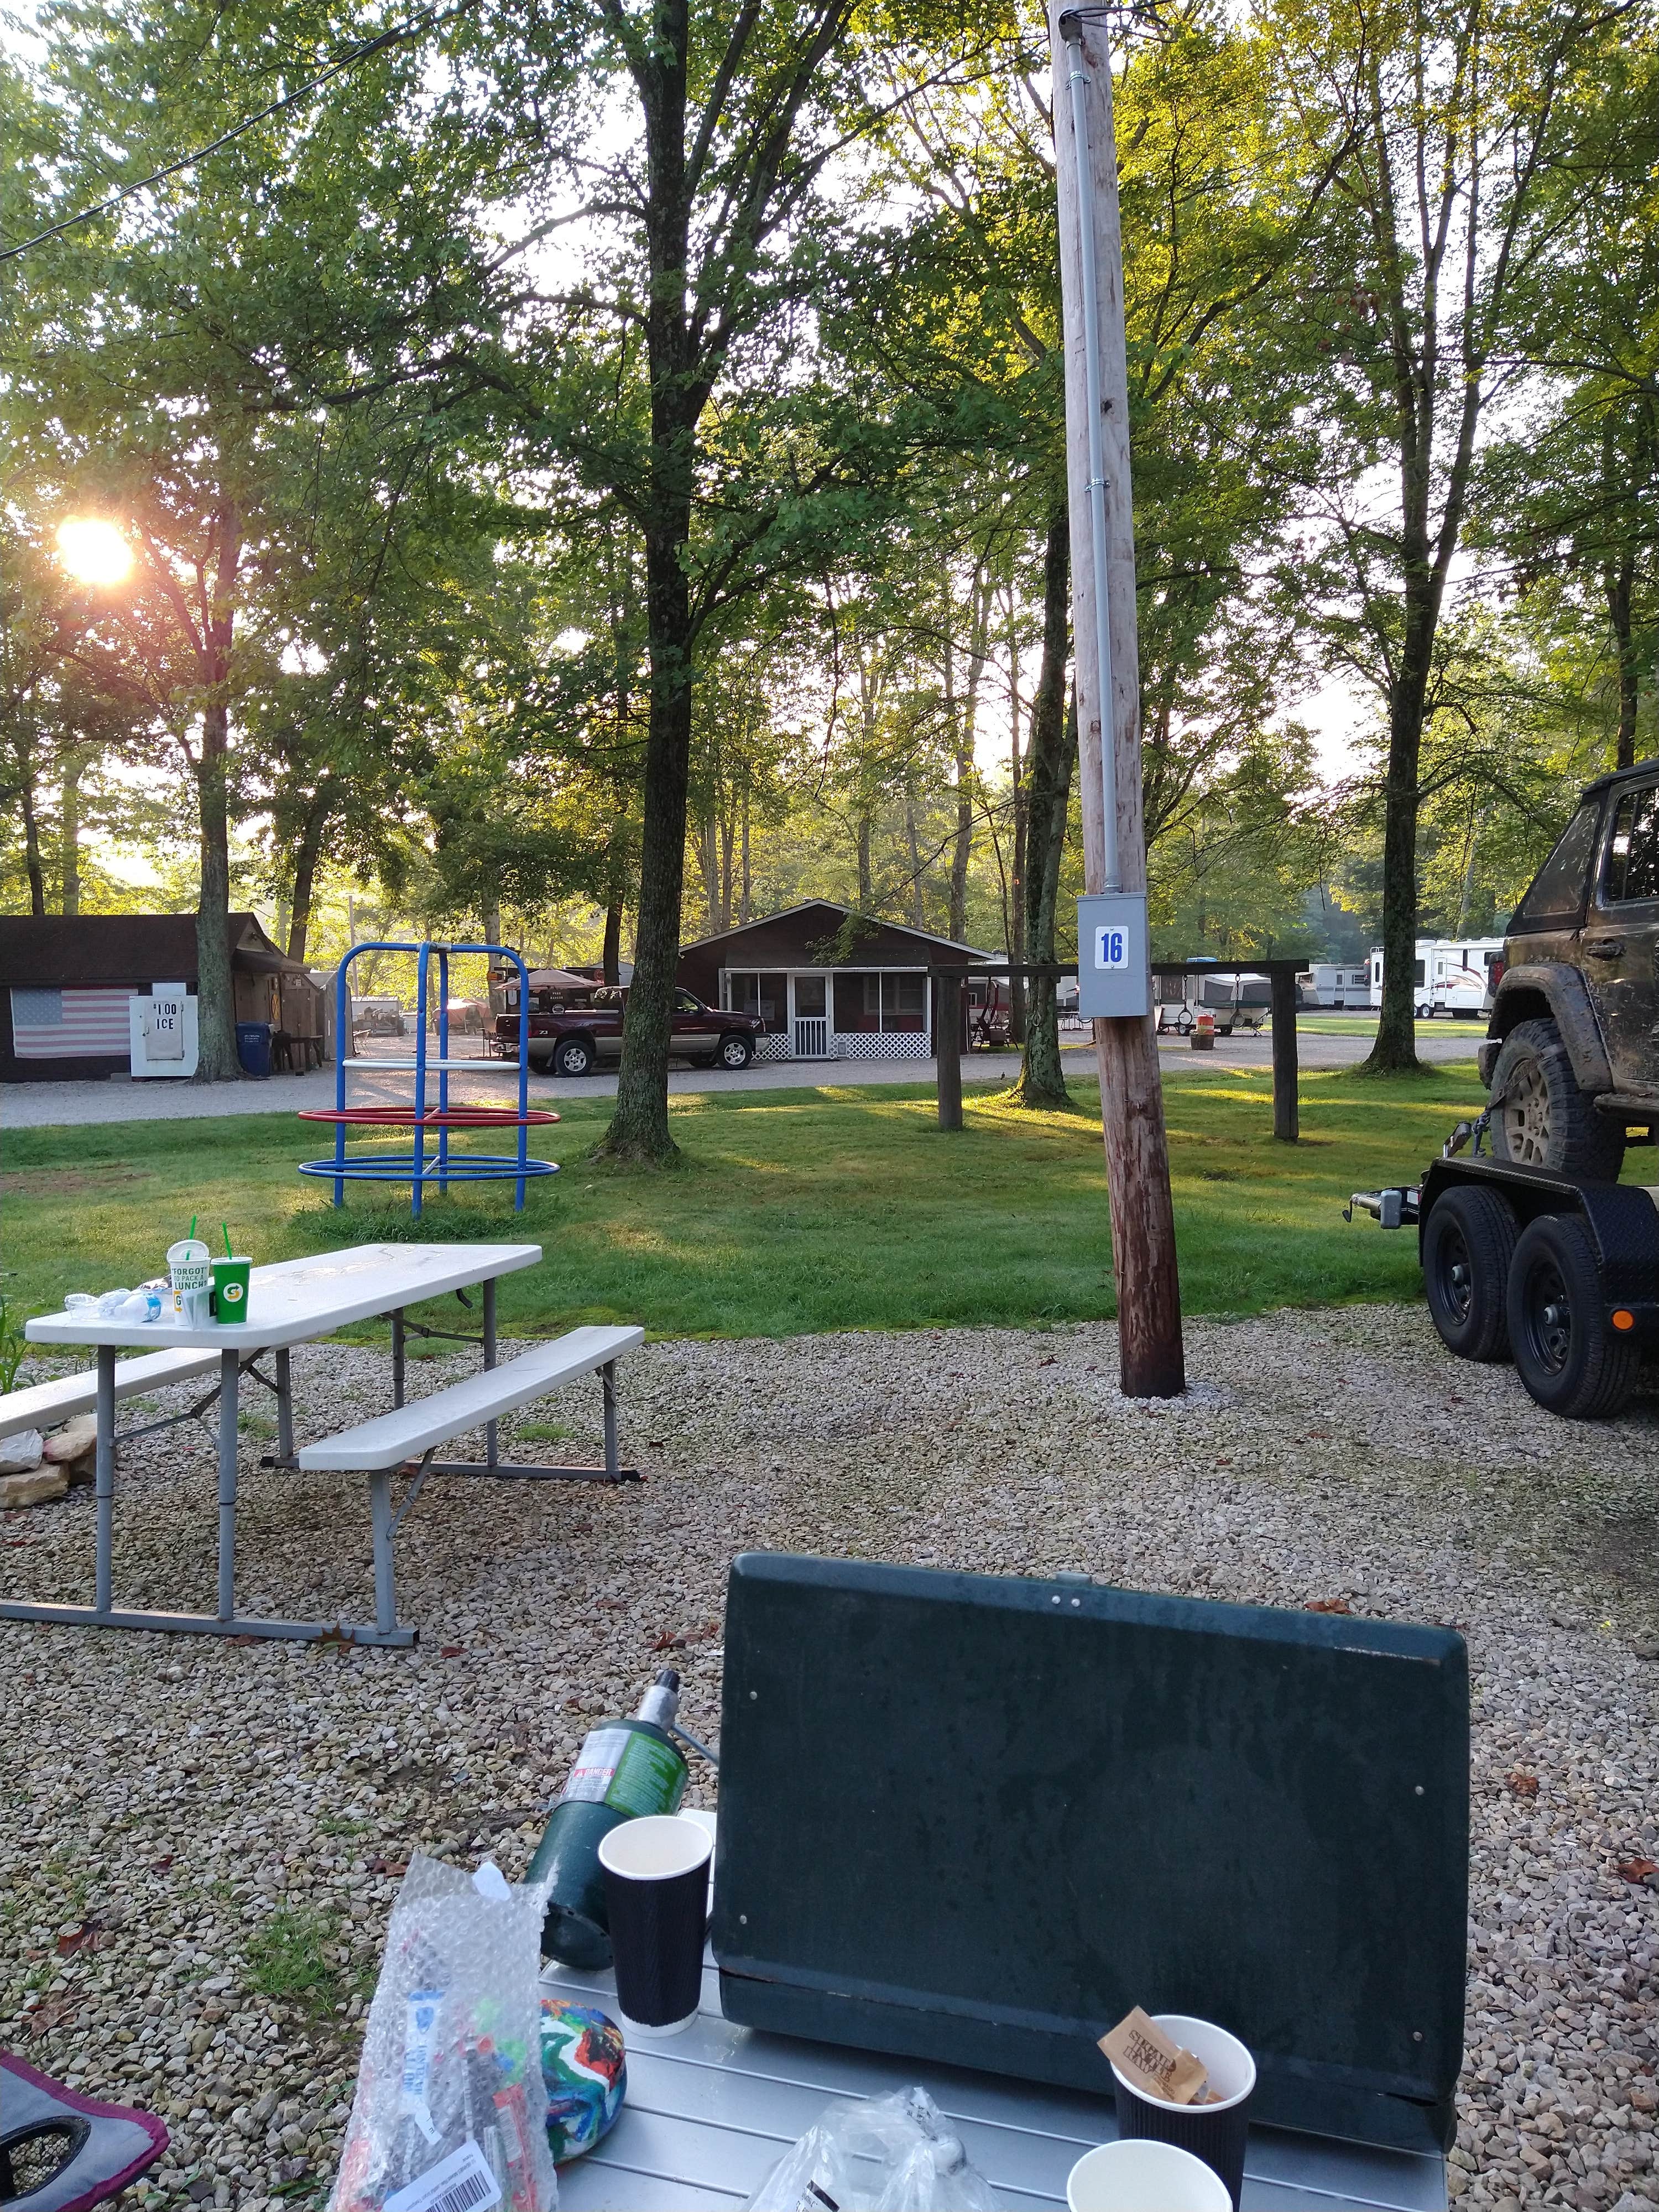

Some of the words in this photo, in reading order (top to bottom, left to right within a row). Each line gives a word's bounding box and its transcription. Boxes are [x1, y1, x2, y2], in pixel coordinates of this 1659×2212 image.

[1101, 932, 1123, 962] 16
[157, 1019, 174, 1029] ICE
[175, 1280, 207, 1290] LUNCH?
[585, 1768, 612, 1776] DANGER
[1123, 2046, 1154, 2074] RAW
